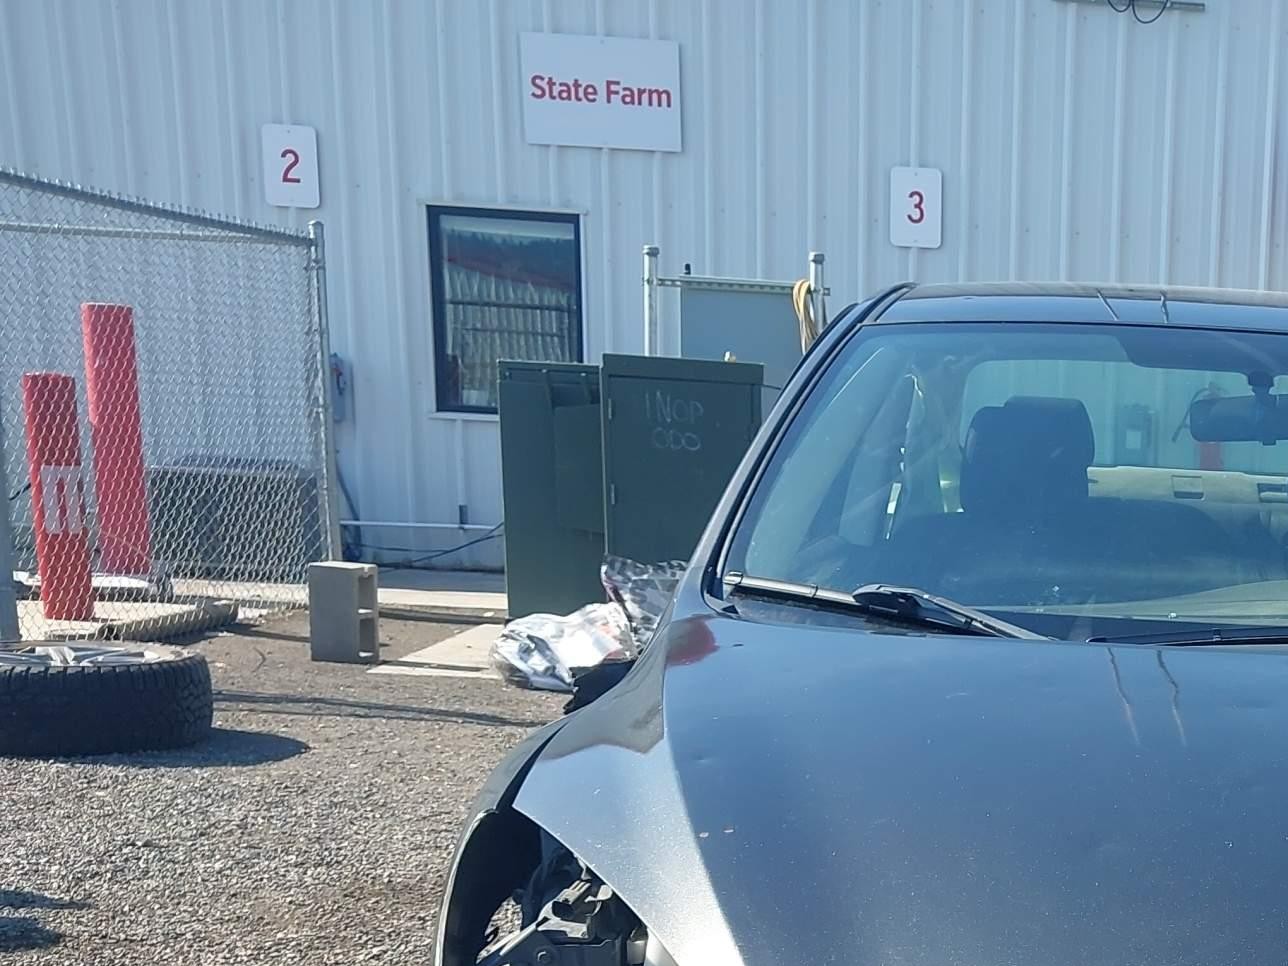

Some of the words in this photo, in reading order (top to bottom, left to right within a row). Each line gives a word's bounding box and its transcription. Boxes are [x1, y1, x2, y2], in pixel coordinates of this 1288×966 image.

[531, 75, 598, 103] State
[606, 80, 672, 108] Farm
[280, 149, 301, 183] 2
[906, 191, 925, 224] 3
